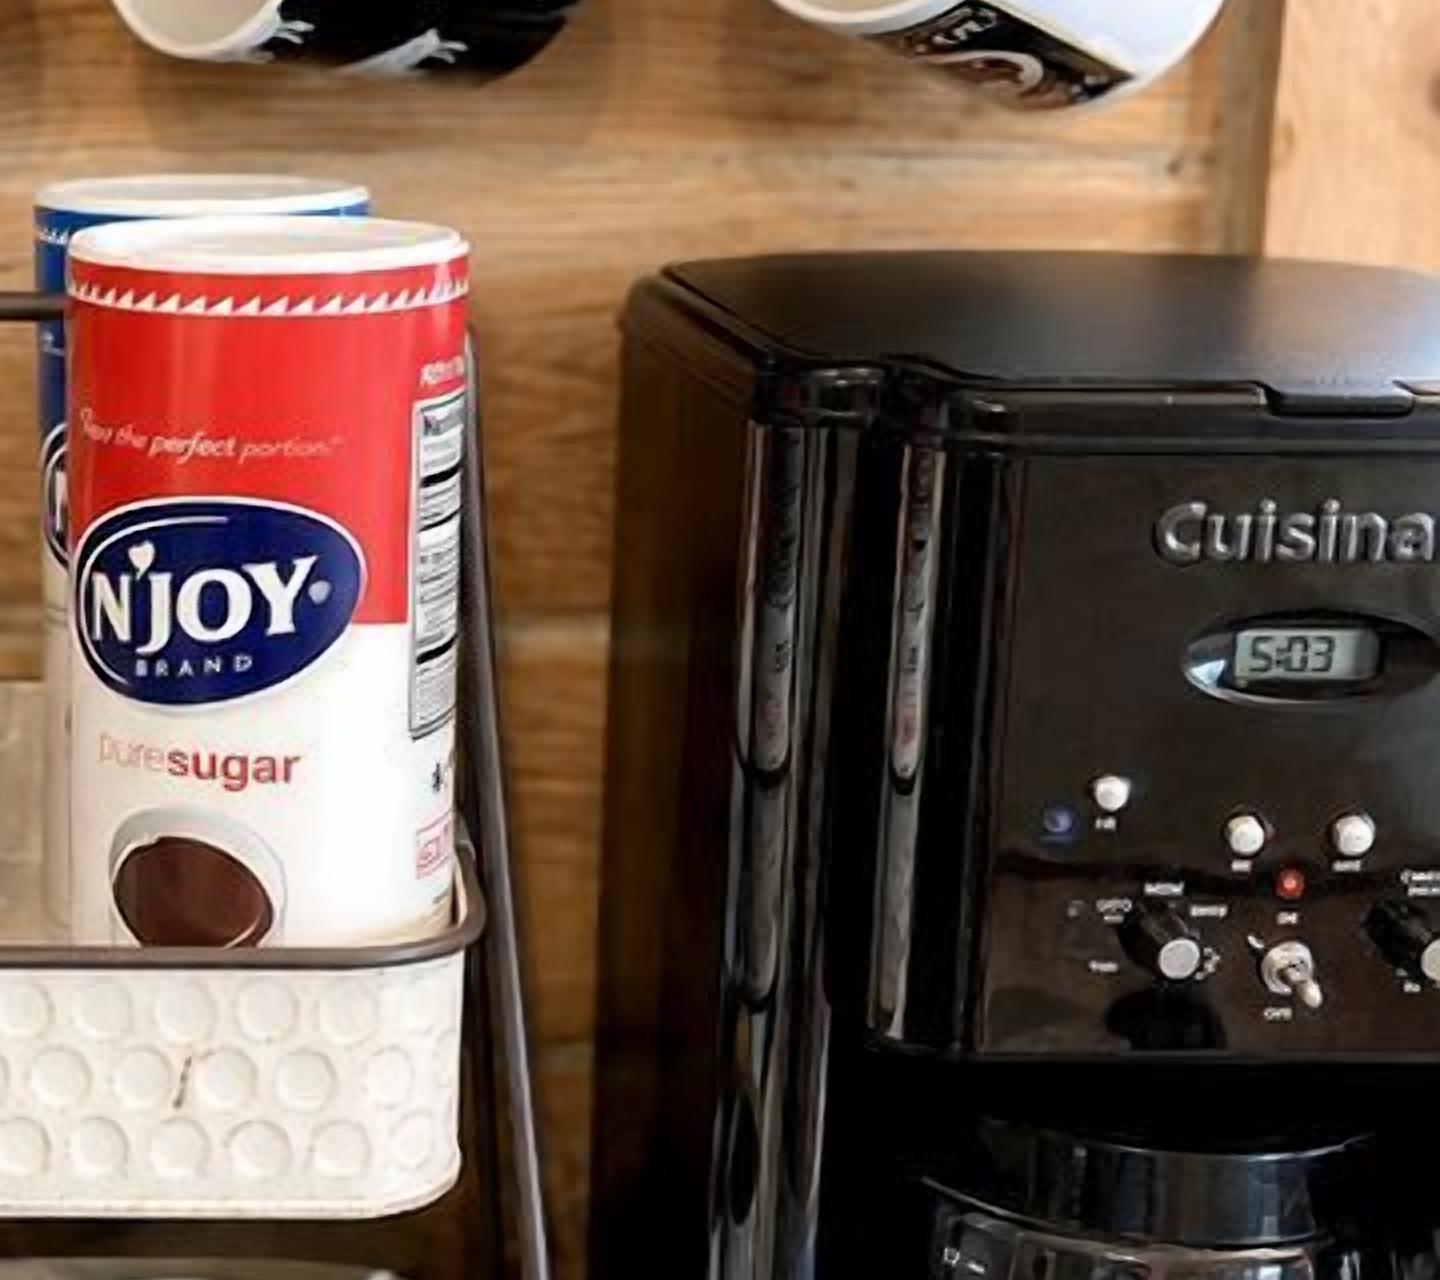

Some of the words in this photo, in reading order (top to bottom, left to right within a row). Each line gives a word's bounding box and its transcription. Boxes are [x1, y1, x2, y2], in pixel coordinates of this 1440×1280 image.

[148, 430, 237, 466] perfect
[135, 654, 254, 677] BRAND
[1247, 634, 1336, 674] 5:03
